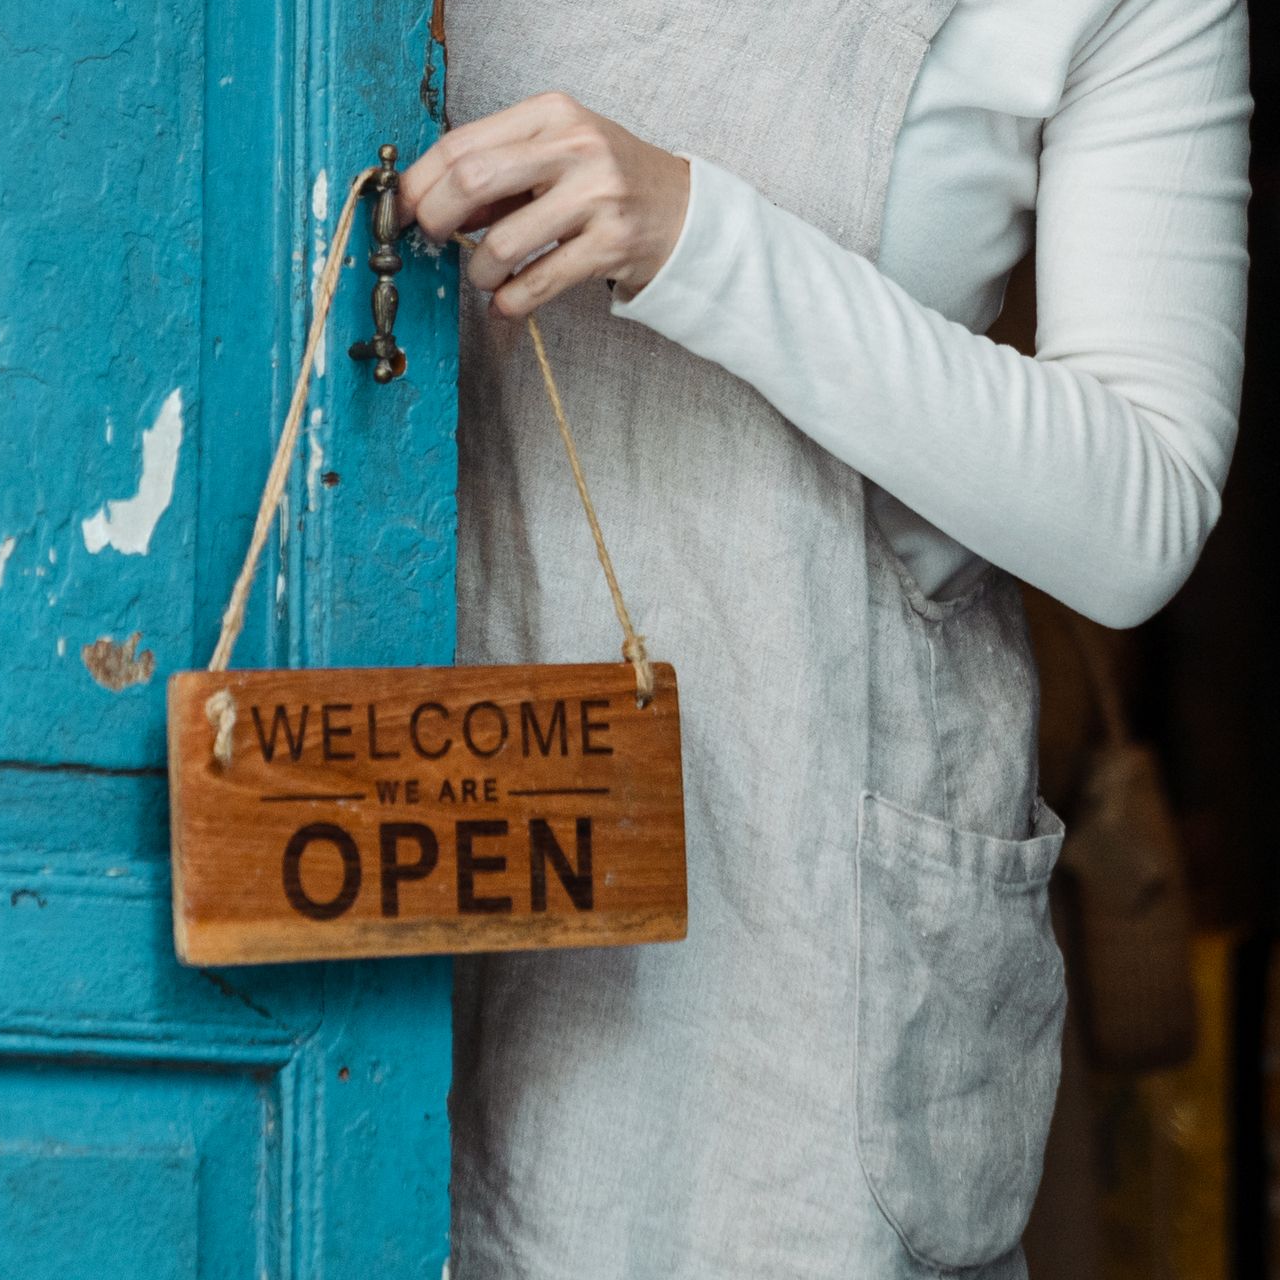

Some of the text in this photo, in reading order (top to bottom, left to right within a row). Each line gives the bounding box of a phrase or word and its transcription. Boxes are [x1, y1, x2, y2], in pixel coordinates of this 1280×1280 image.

[250, 696, 614, 764] WELCOME
[376, 777, 499, 805] WE ARE
[282, 816, 595, 921] OPEN
